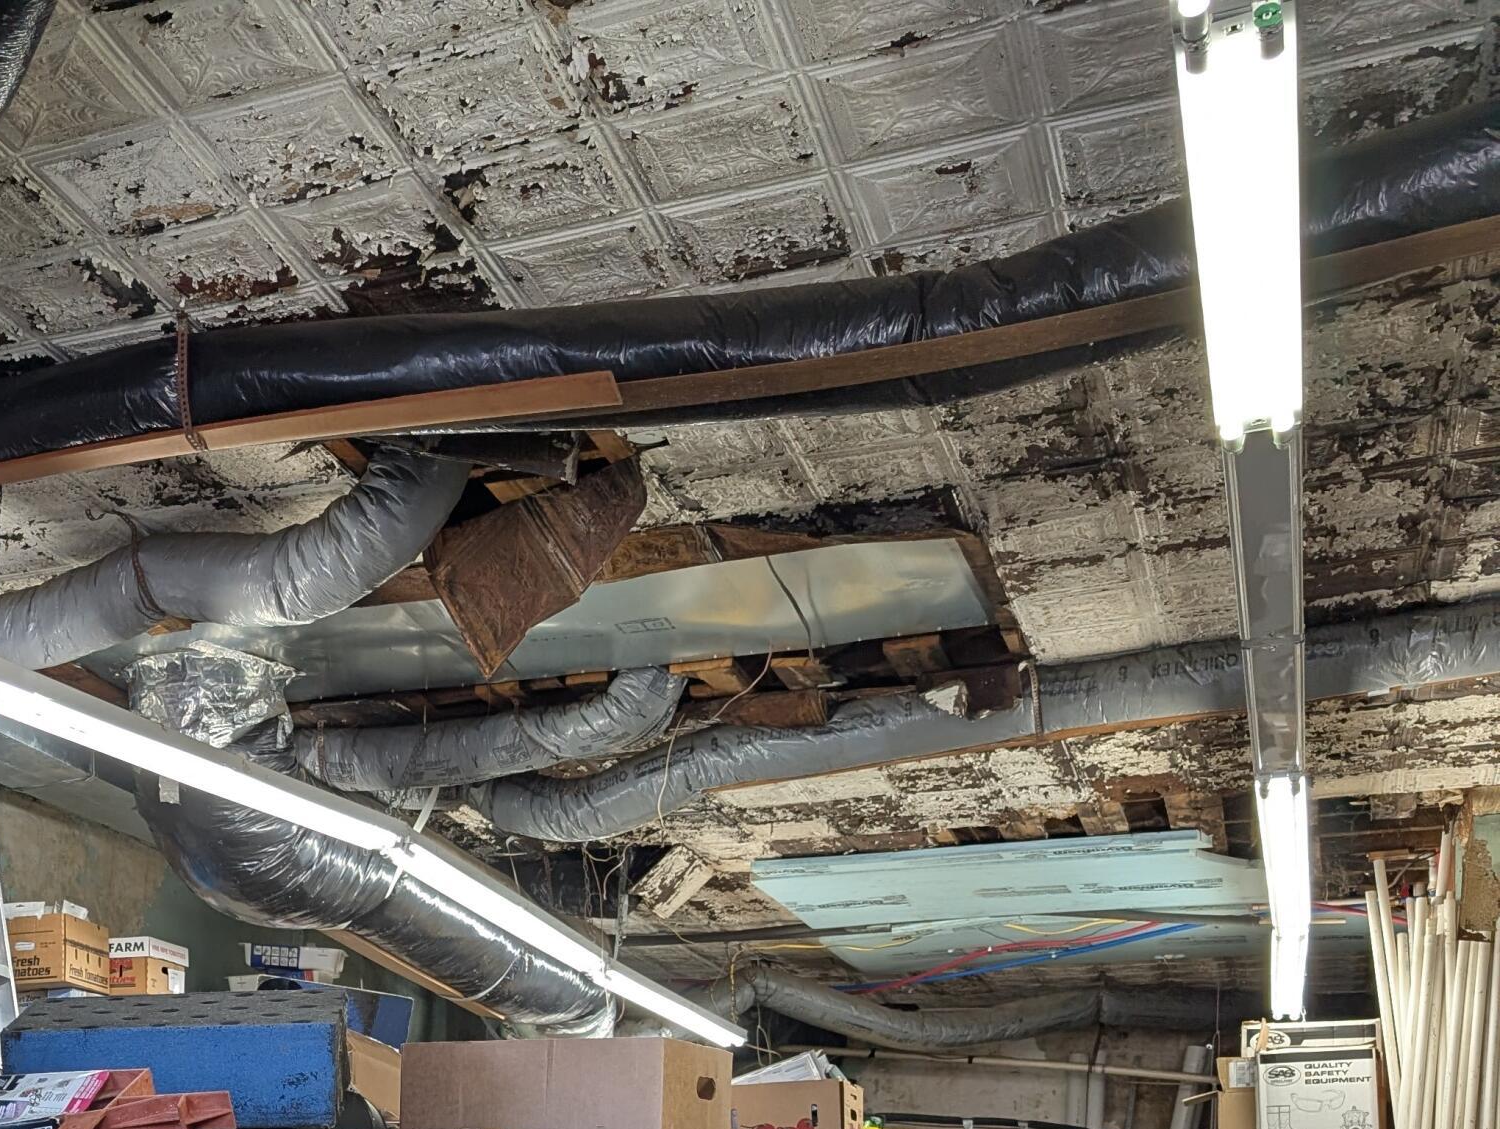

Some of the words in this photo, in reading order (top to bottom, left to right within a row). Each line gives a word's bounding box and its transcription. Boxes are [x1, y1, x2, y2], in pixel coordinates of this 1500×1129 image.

[109, 942, 145, 954] FARM
[12, 955, 40, 968] Fresh
[69, 963, 84, 979] Fresh
[84, 968, 109, 986] Tomatoes
[1304, 1061, 1353, 1070] QUALITY
[1267, 1069, 1296, 1080] SAS
[1304, 1069, 1349, 1077] SAFETY
[1304, 1076, 1372, 1085] EQUIPMENT
